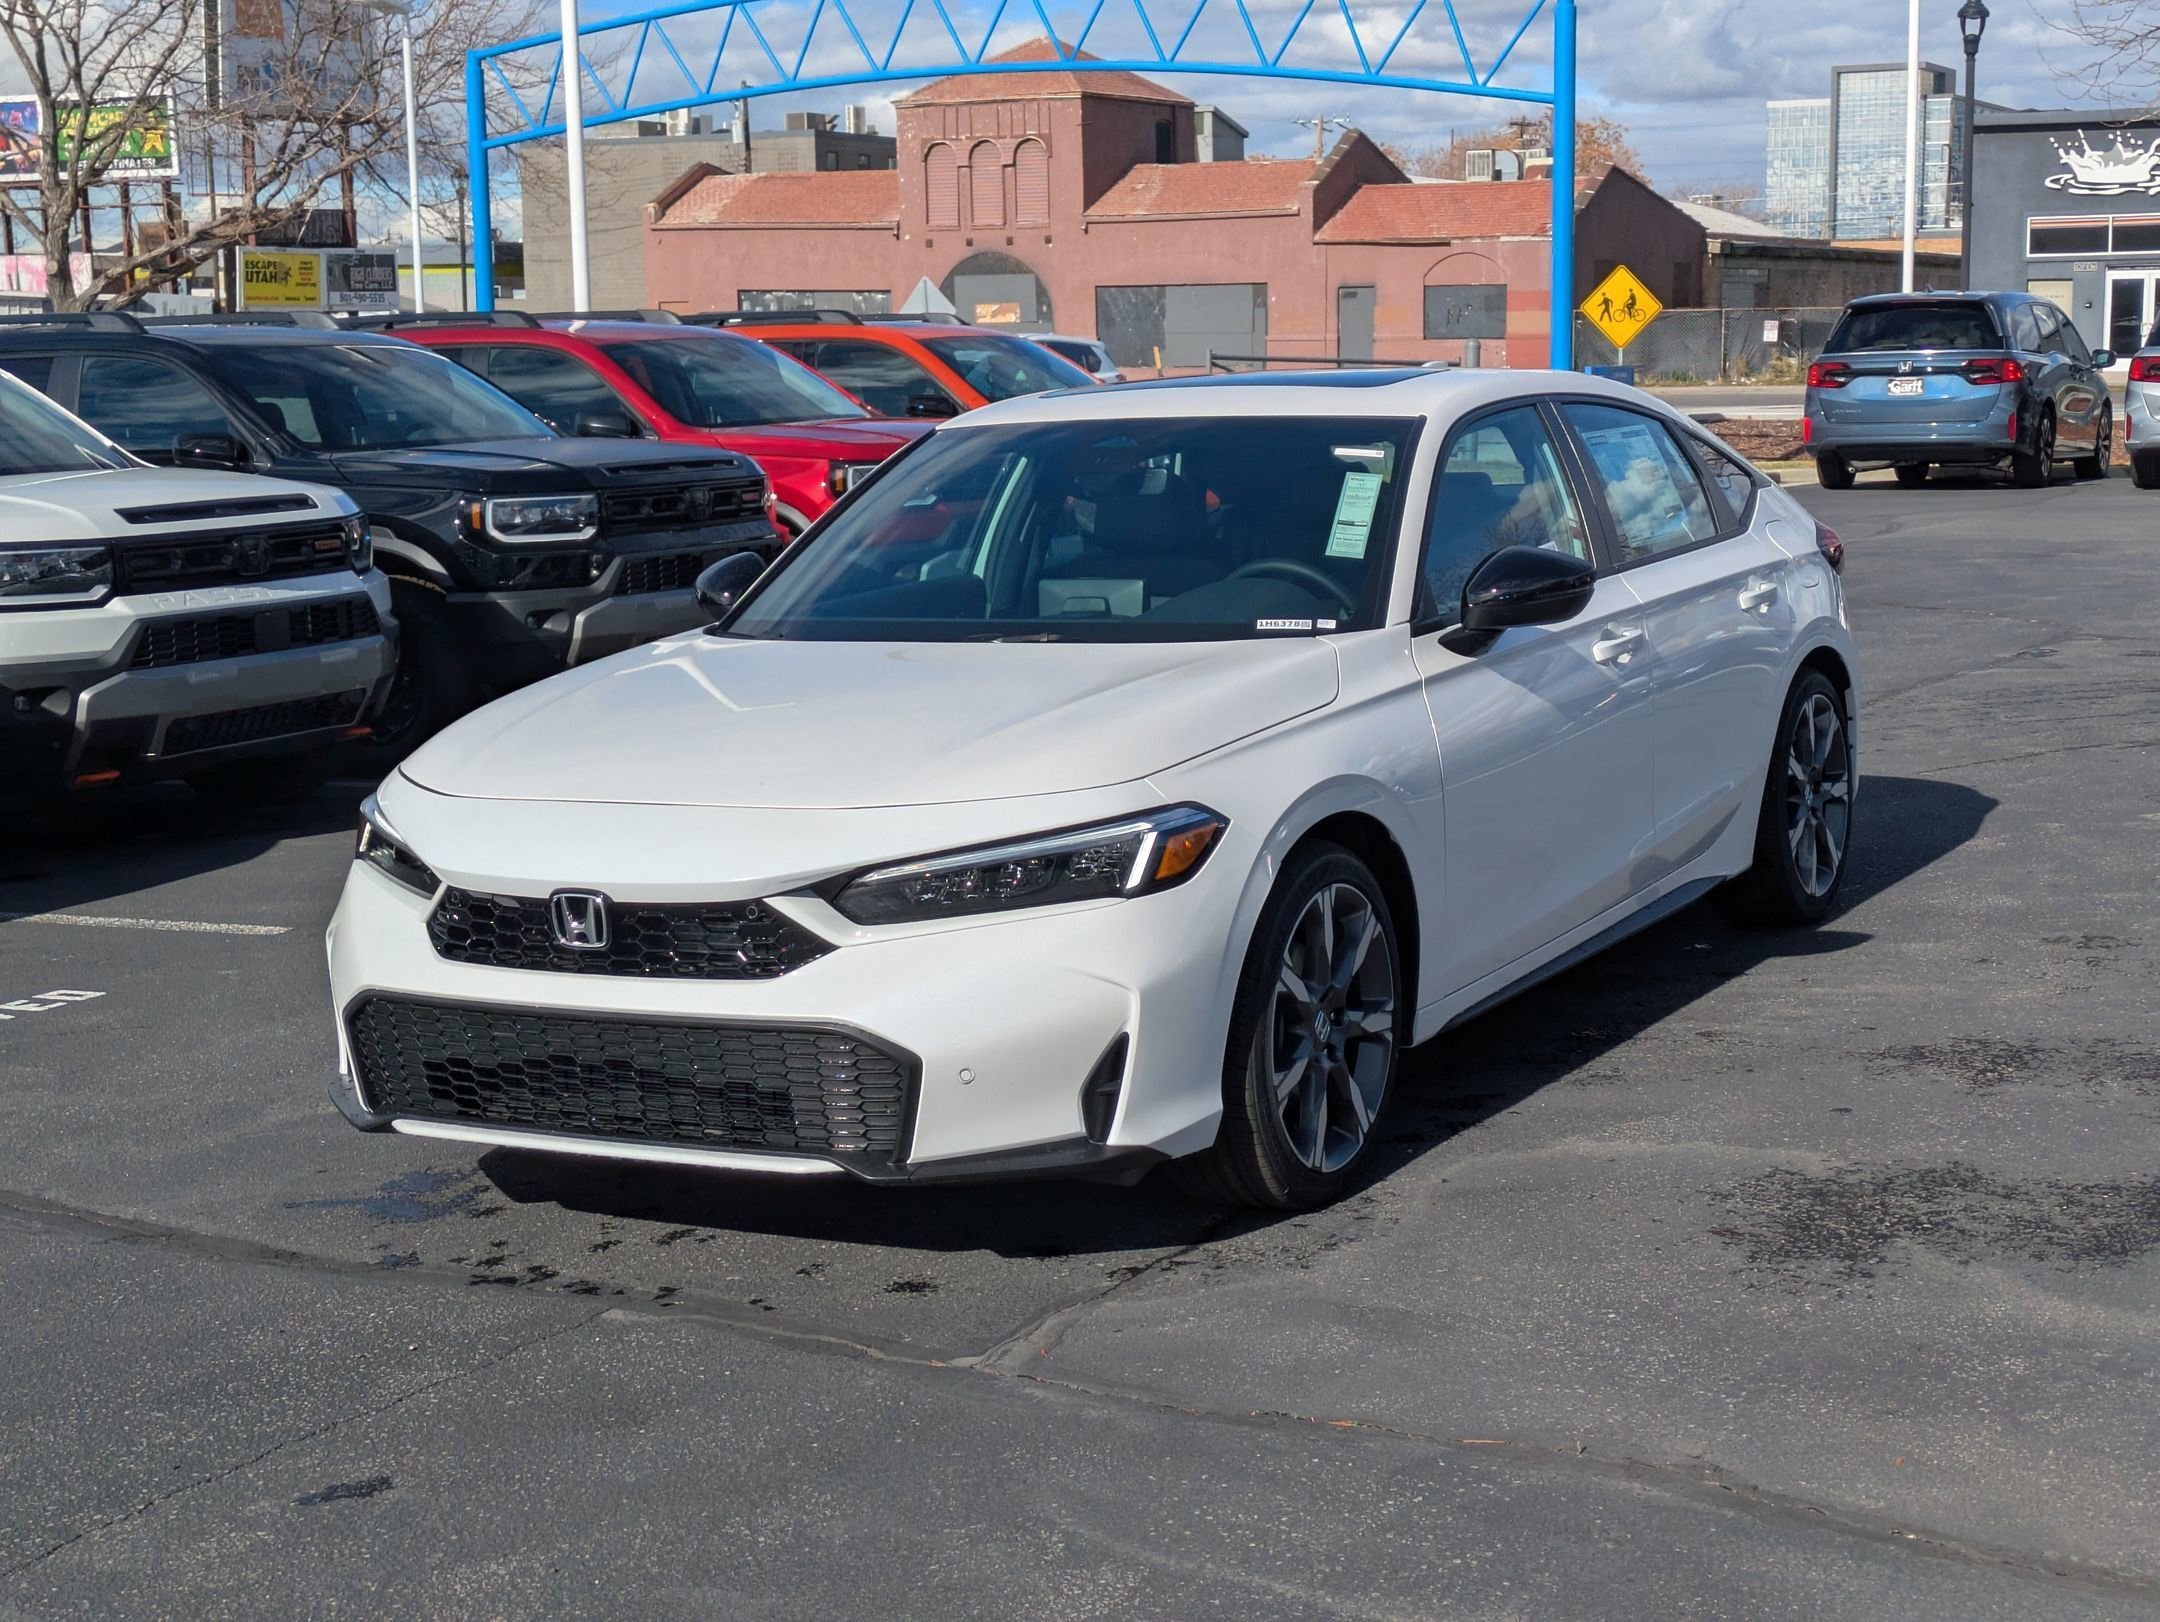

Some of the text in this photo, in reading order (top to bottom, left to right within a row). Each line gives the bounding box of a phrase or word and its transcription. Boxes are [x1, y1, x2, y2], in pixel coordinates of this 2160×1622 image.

[245, 260, 278, 270] ESCAPE
[245, 270, 278, 283] UTAH
[381, 280, 393, 289] LLC
